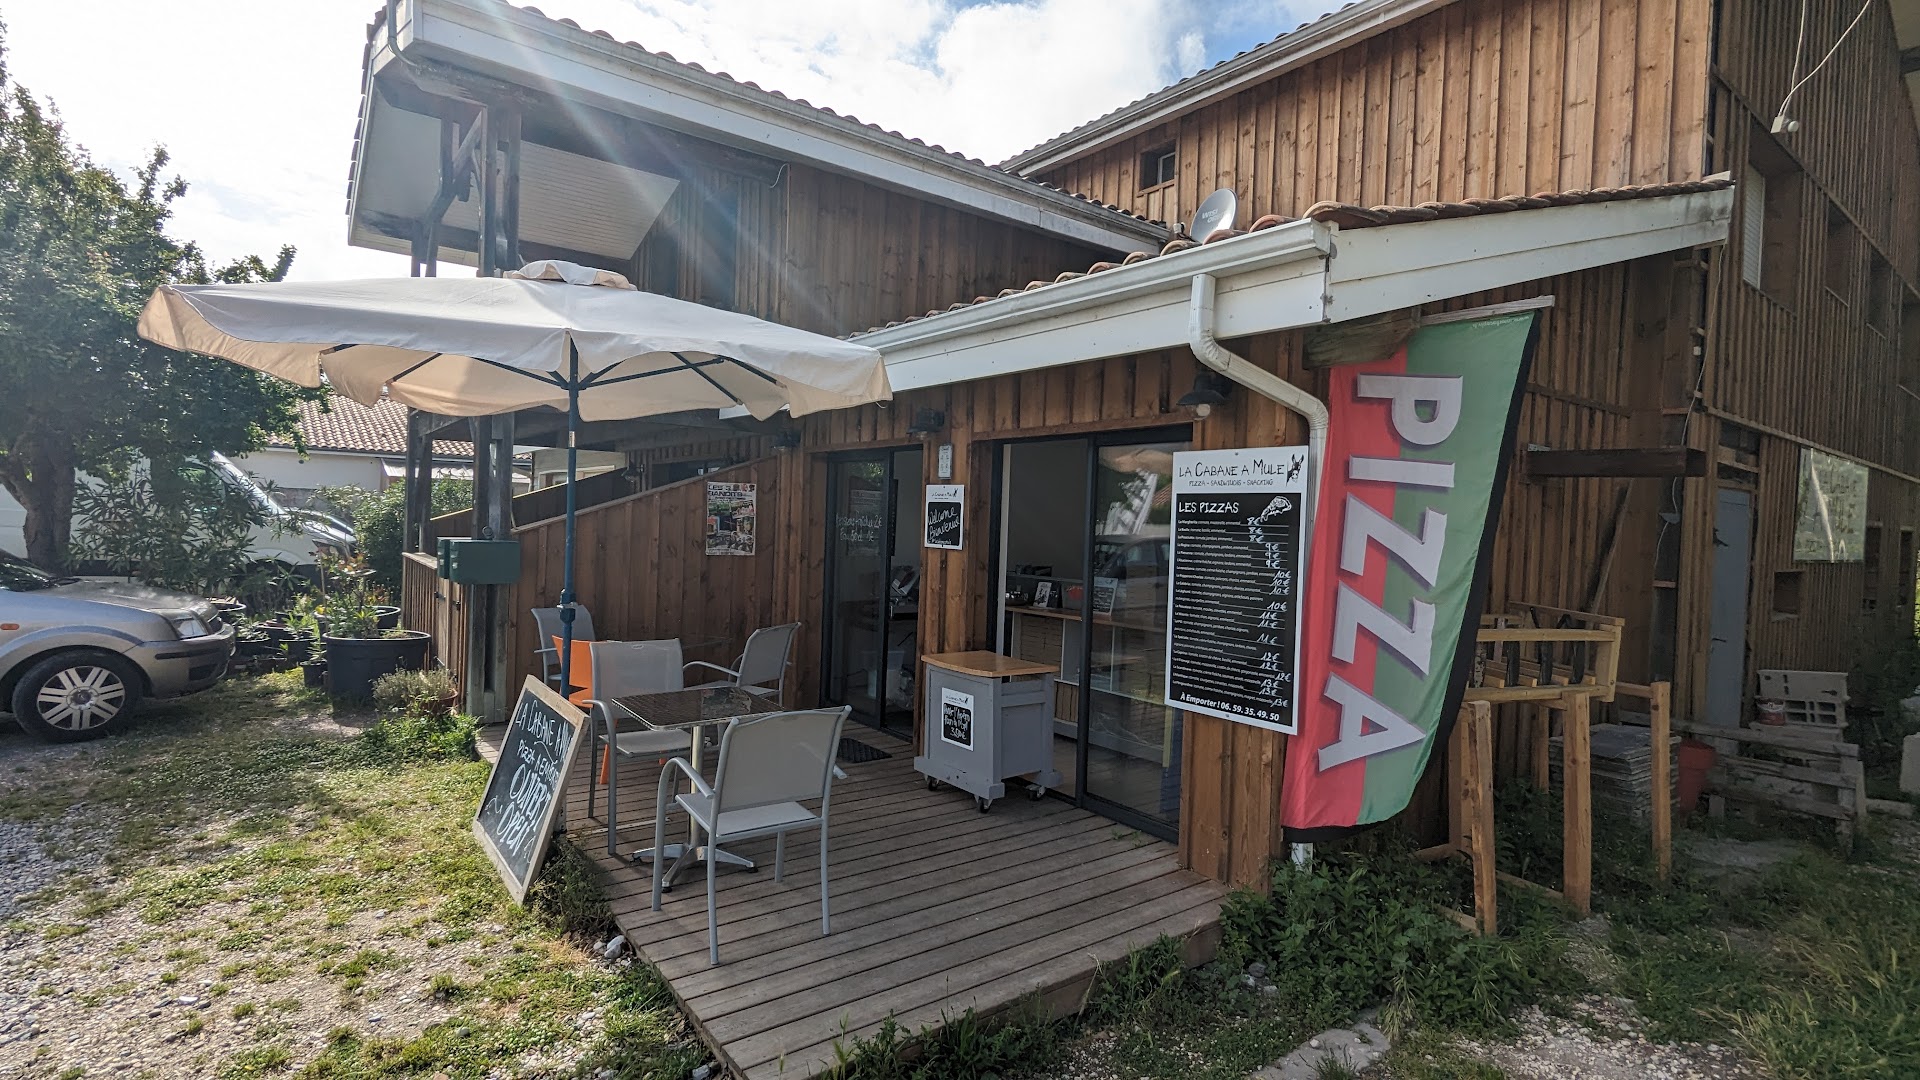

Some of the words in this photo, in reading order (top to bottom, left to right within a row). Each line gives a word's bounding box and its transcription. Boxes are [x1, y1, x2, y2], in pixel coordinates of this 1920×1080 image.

[1179, 466, 1192, 478] LA
[1178, 502, 1196, 513] LES
[1199, 502, 1239, 513] PIZZAS
[1317, 373, 1464, 772] PIZZA
[1186, 694, 1217, 707] Emporter
[1270, 713, 1279, 721] 50
[510, 763, 551, 833] OUVERT
[497, 801, 530, 857] OPEN
